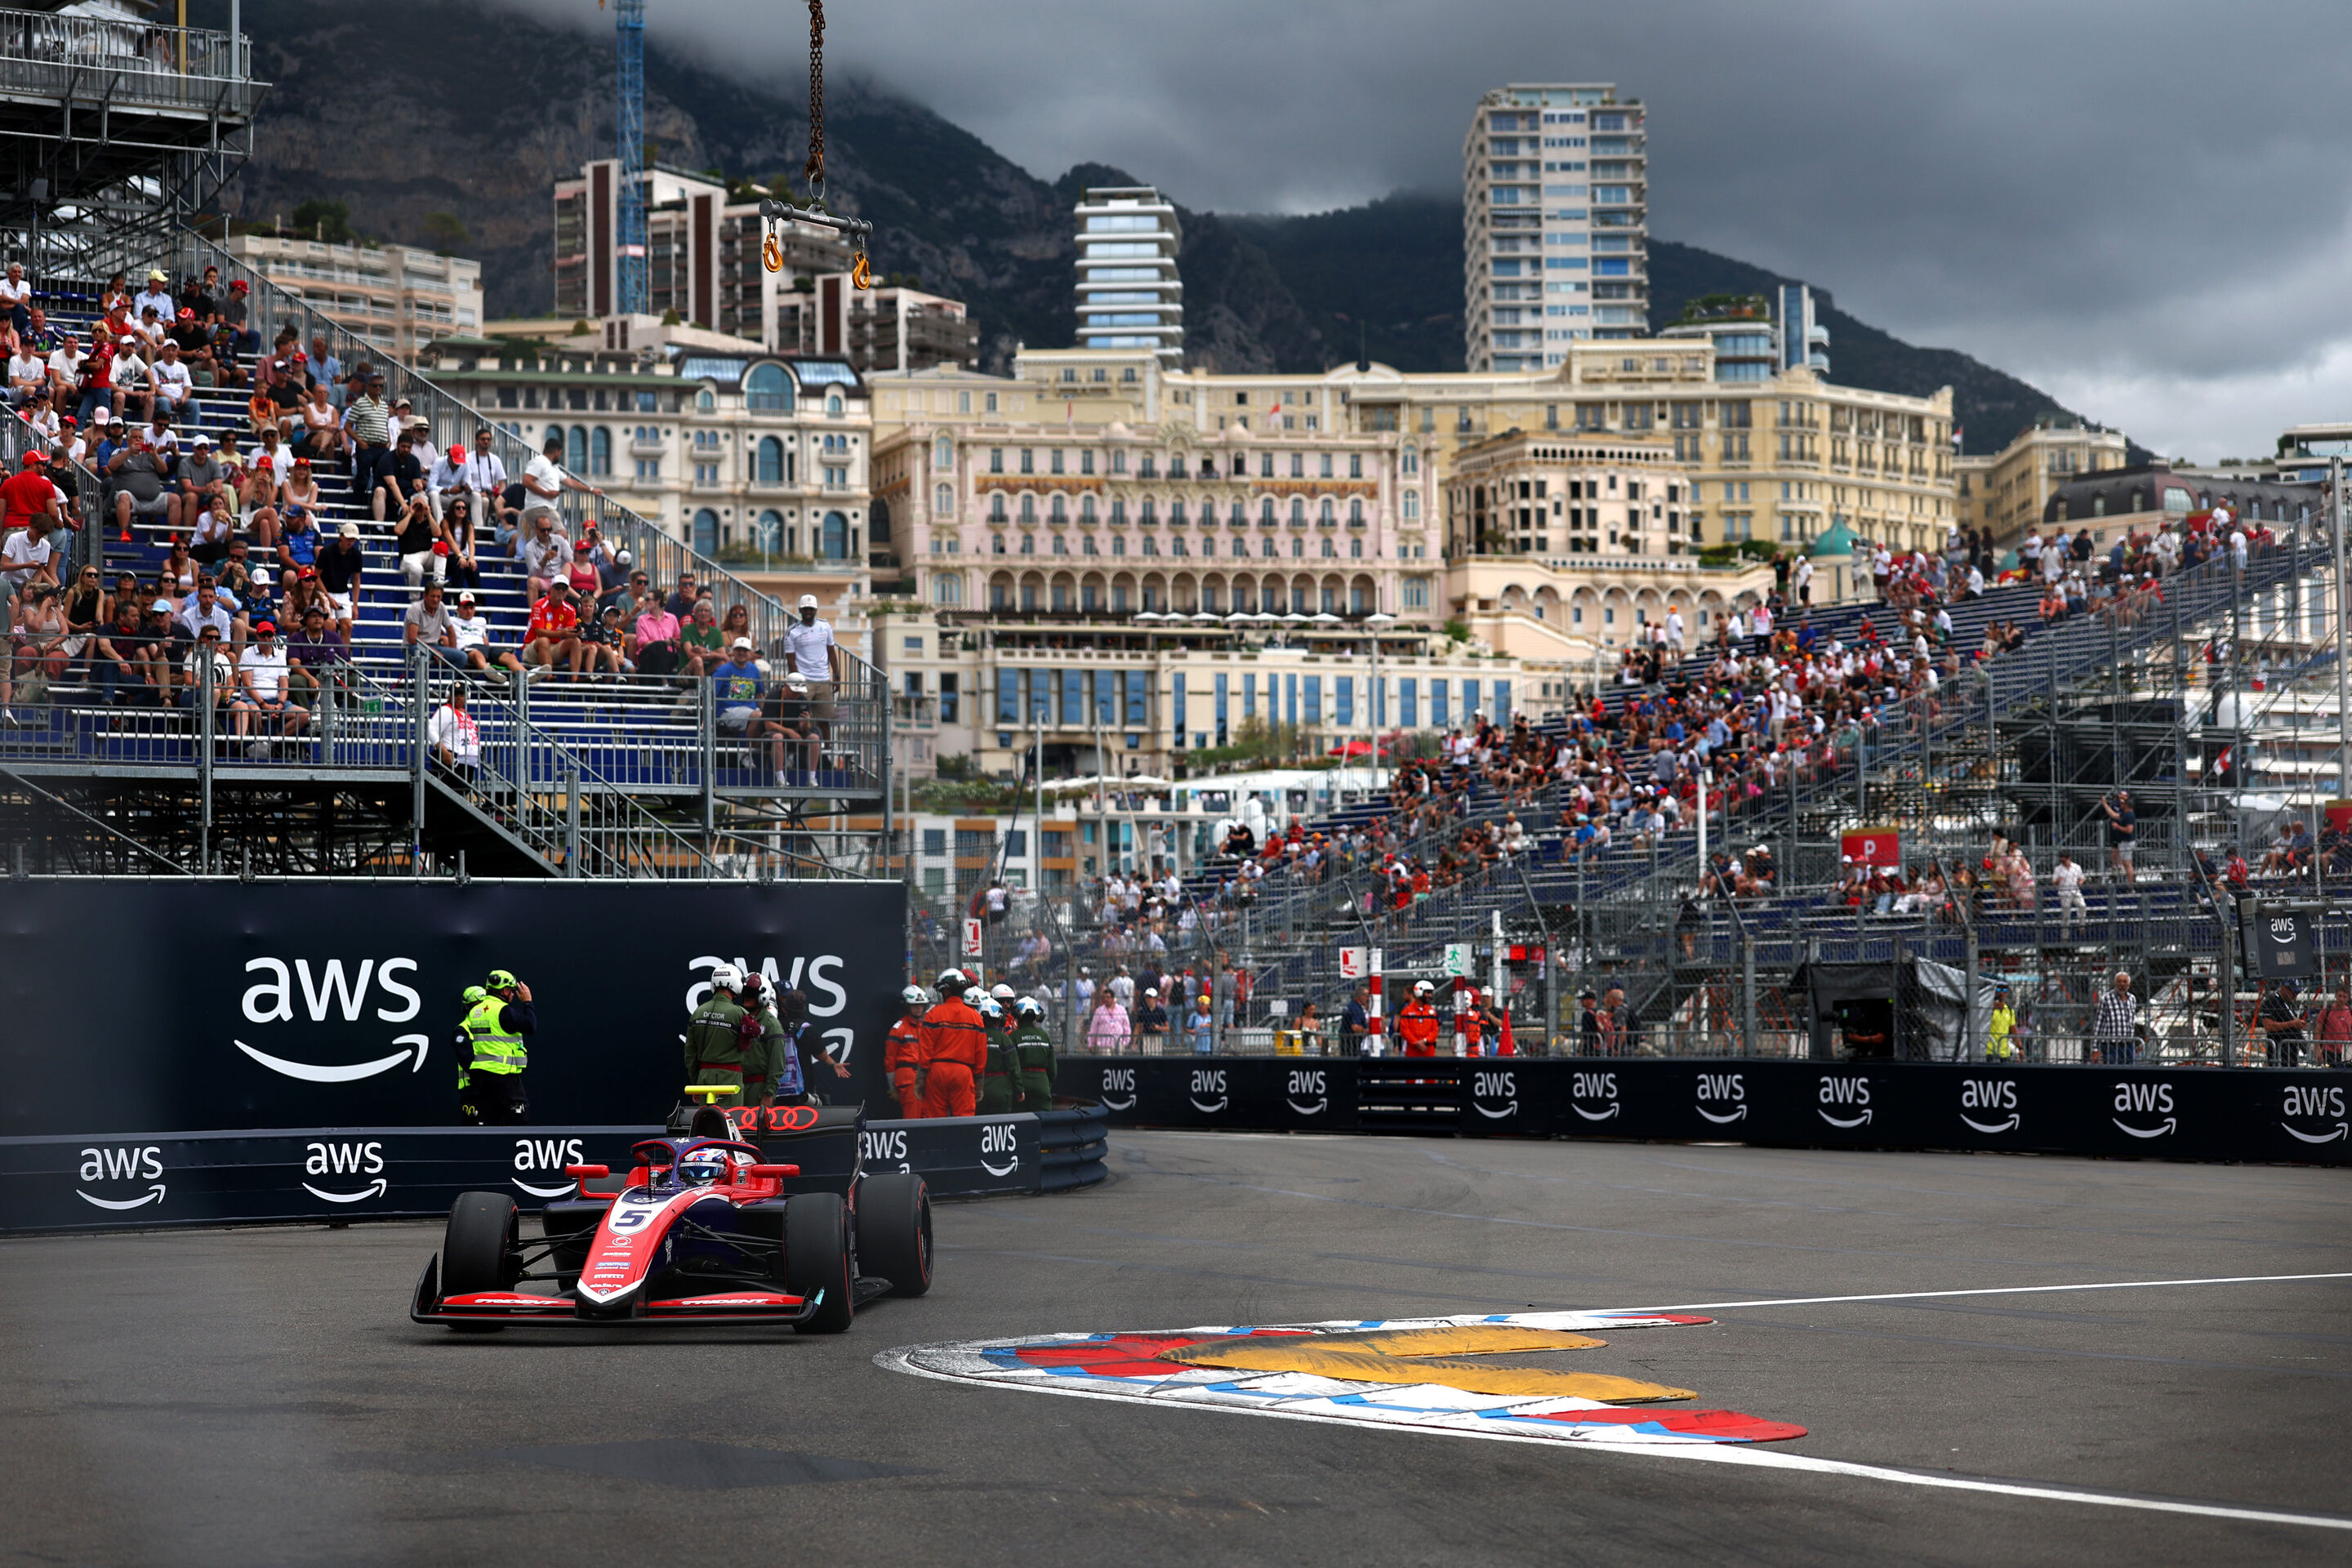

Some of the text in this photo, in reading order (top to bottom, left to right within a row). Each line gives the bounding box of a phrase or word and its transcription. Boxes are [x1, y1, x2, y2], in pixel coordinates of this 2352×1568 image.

[2270, 917, 2294, 932] aws
[242, 956, 421, 1023] aws
[1102, 1068, 1135, 1091] aws
[1191, 1070, 1227, 1093] aws
[1288, 1070, 1325, 1094] aws
[1474, 1071, 1516, 1097] aws
[1573, 1072, 1618, 1098] aws
[1697, 1073, 1744, 1101] aws
[1820, 1076, 1870, 1105] aws
[1962, 1080, 2017, 1109] aws
[2115, 1082, 2174, 1113] aws
[2283, 1085, 2345, 1117] aws
[865, 1130, 907, 1160] aws
[982, 1124, 1017, 1153] aws
[80, 1147, 163, 1182] aws
[305, 1142, 384, 1175] aws
[514, 1138, 584, 1170] aws
[614, 1209, 652, 1227] 5
